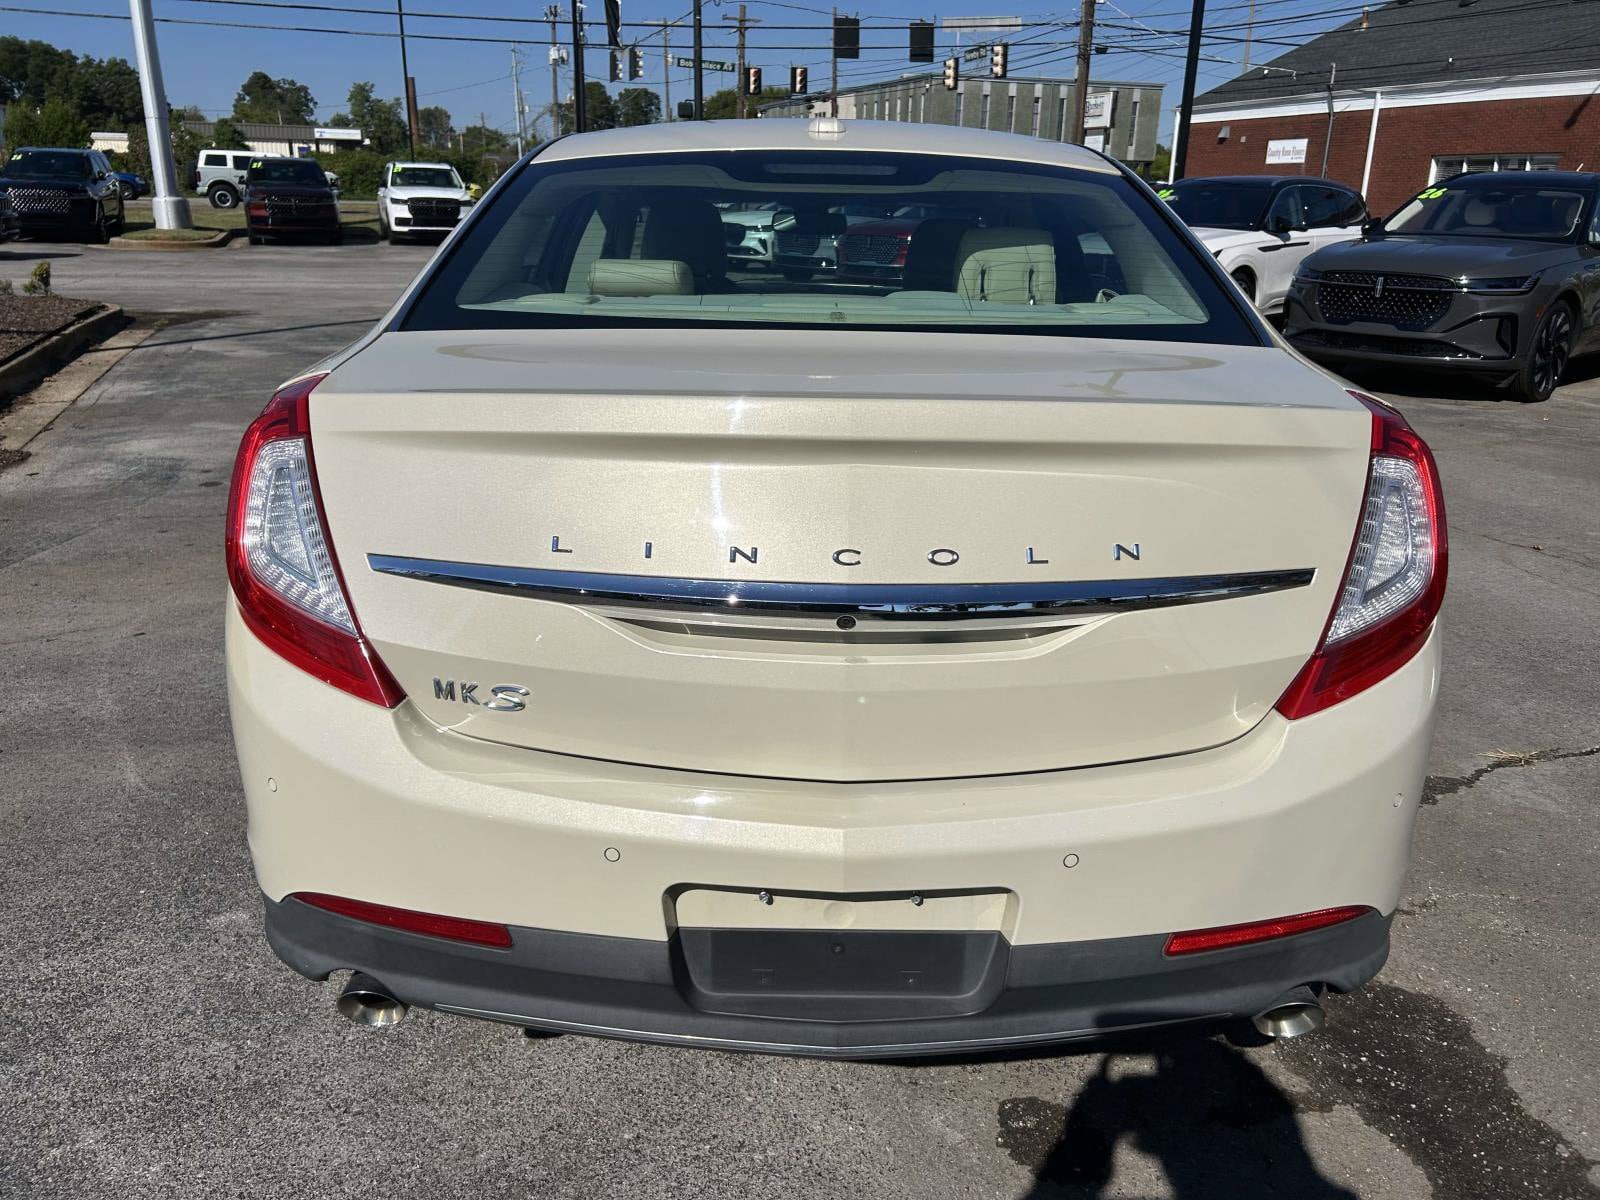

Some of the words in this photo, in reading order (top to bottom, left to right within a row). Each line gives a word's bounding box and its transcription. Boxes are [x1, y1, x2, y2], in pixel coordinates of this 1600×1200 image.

[701, 61, 721, 70] allace
[1416, 188, 1448, 199] 26
[551, 535, 1140, 567] LINCOLN
[432, 676, 530, 712] MKS
